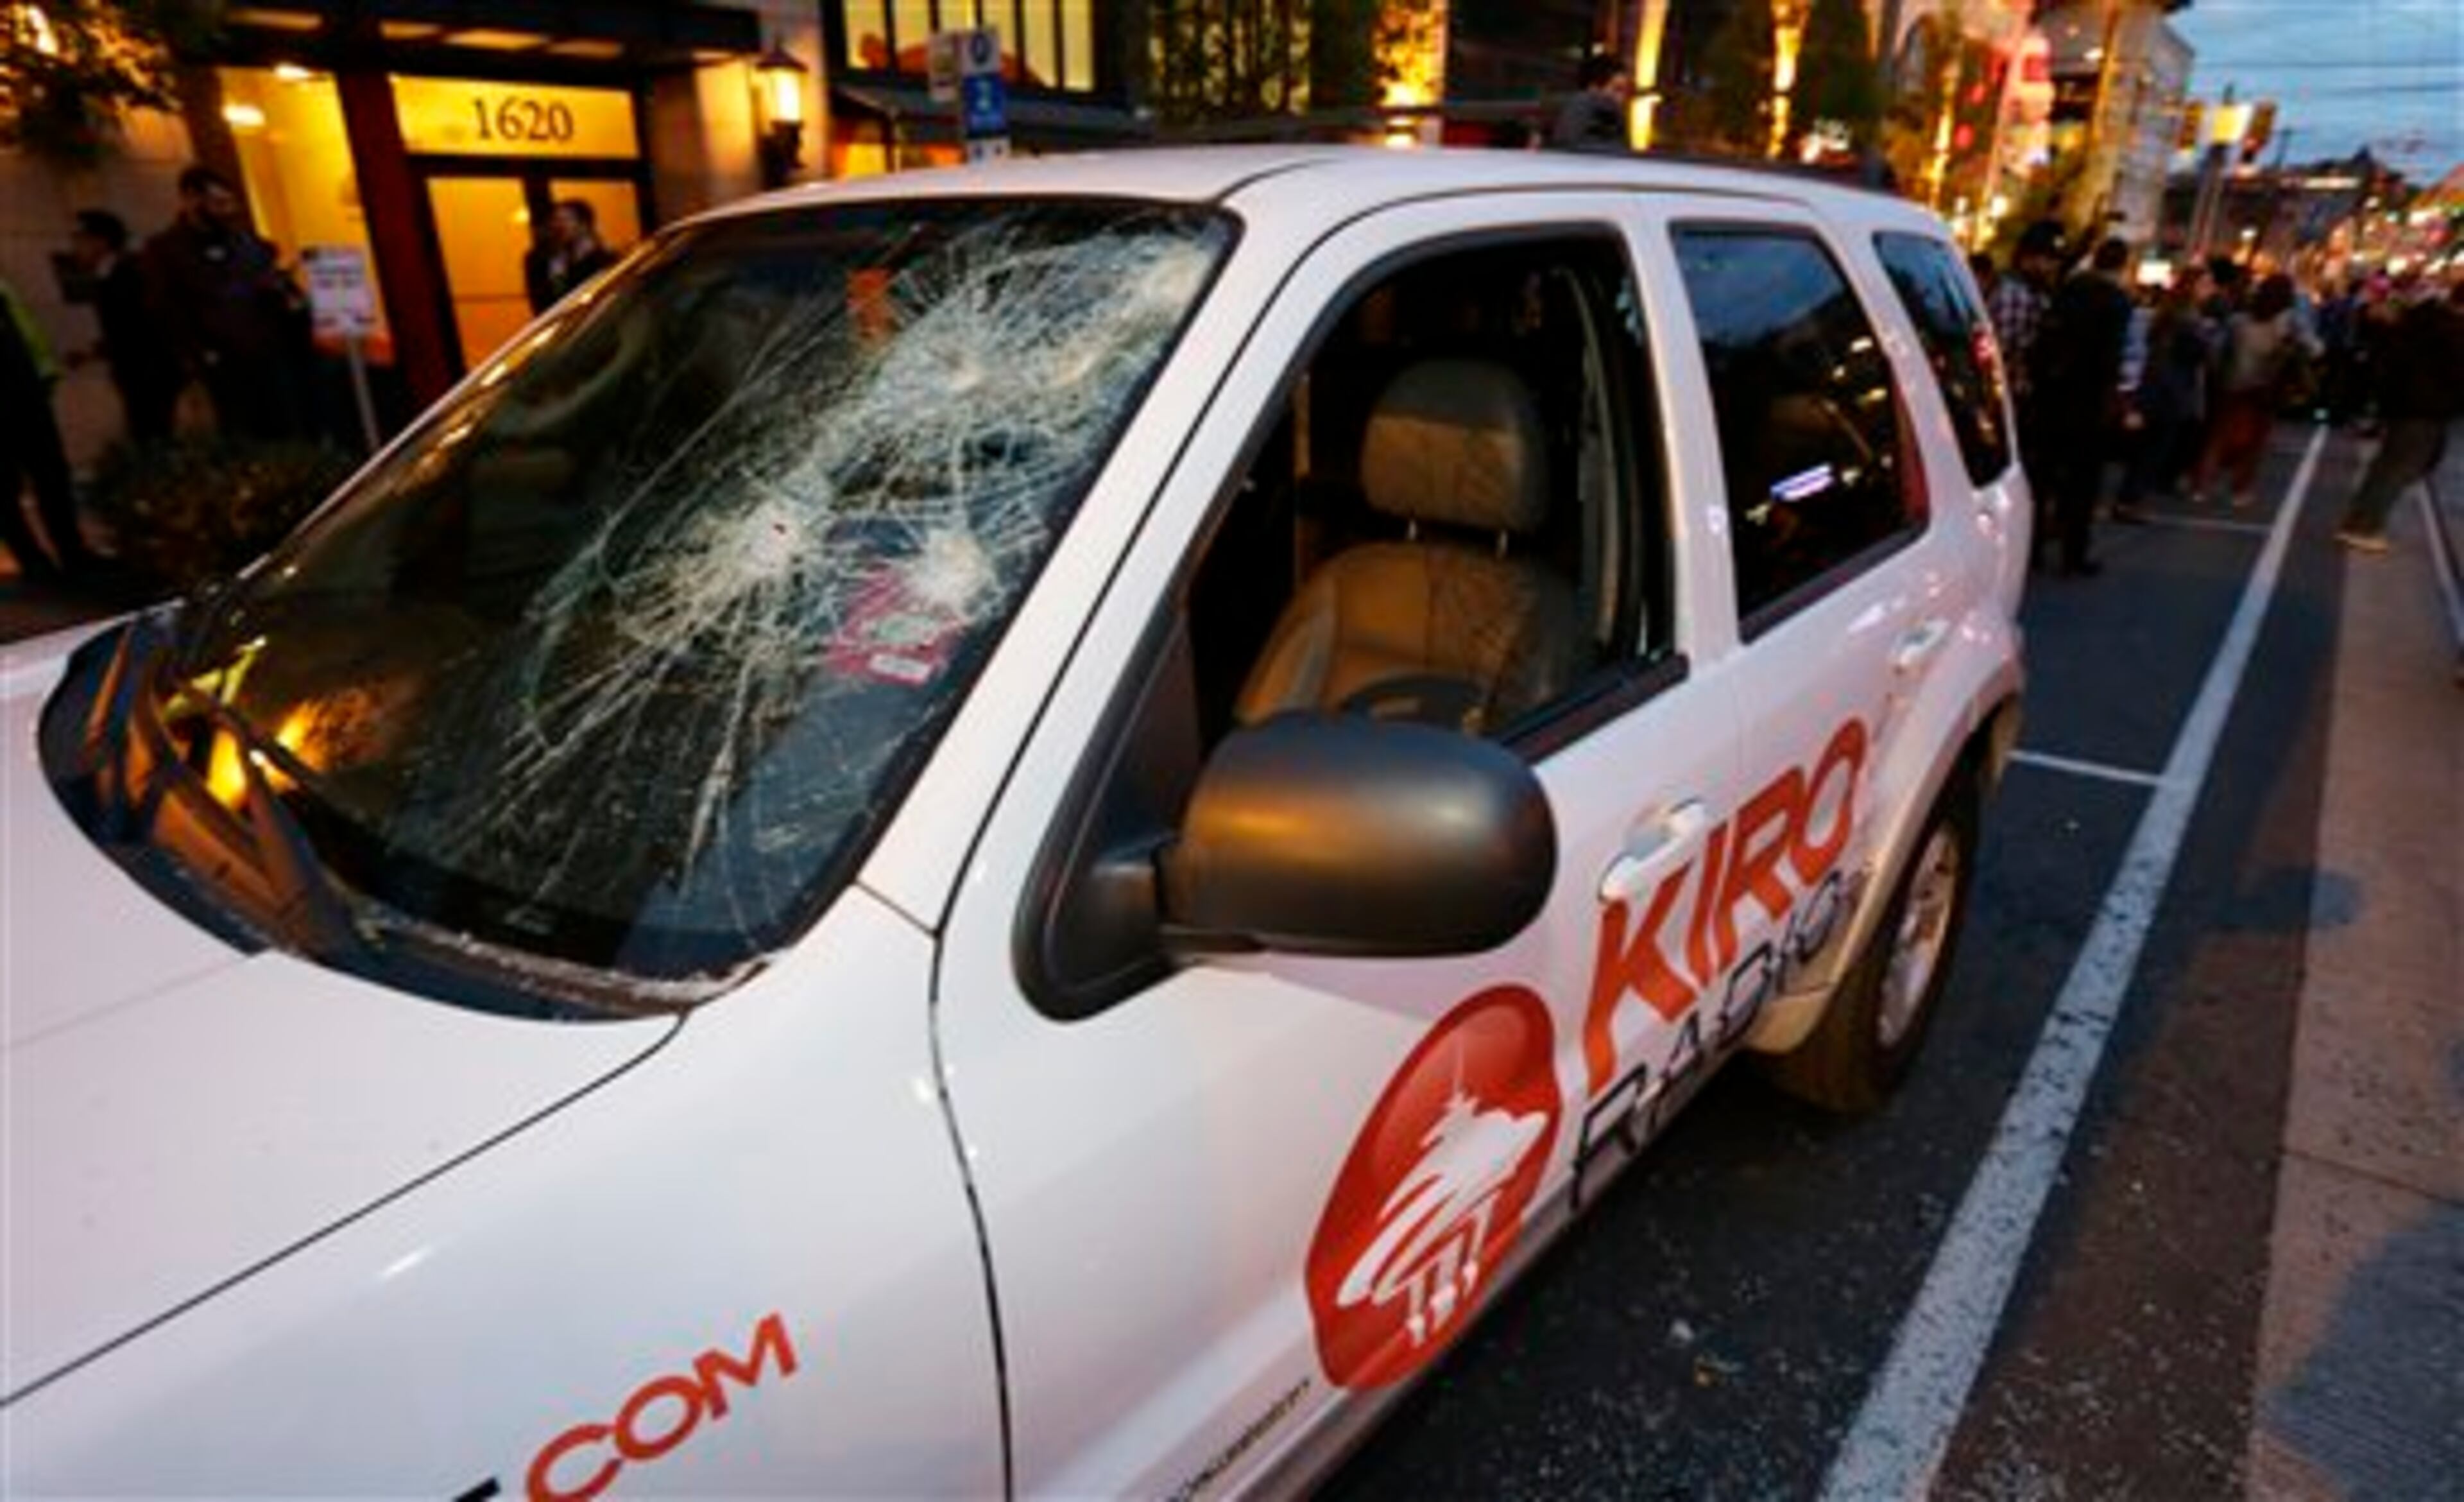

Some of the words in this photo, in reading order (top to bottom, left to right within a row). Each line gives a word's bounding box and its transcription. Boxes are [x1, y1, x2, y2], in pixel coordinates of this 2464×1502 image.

[472, 96, 574, 142] 1620
[1571, 870, 1843, 1208] RADIO
[1583, 717, 1867, 1099] KIRO
